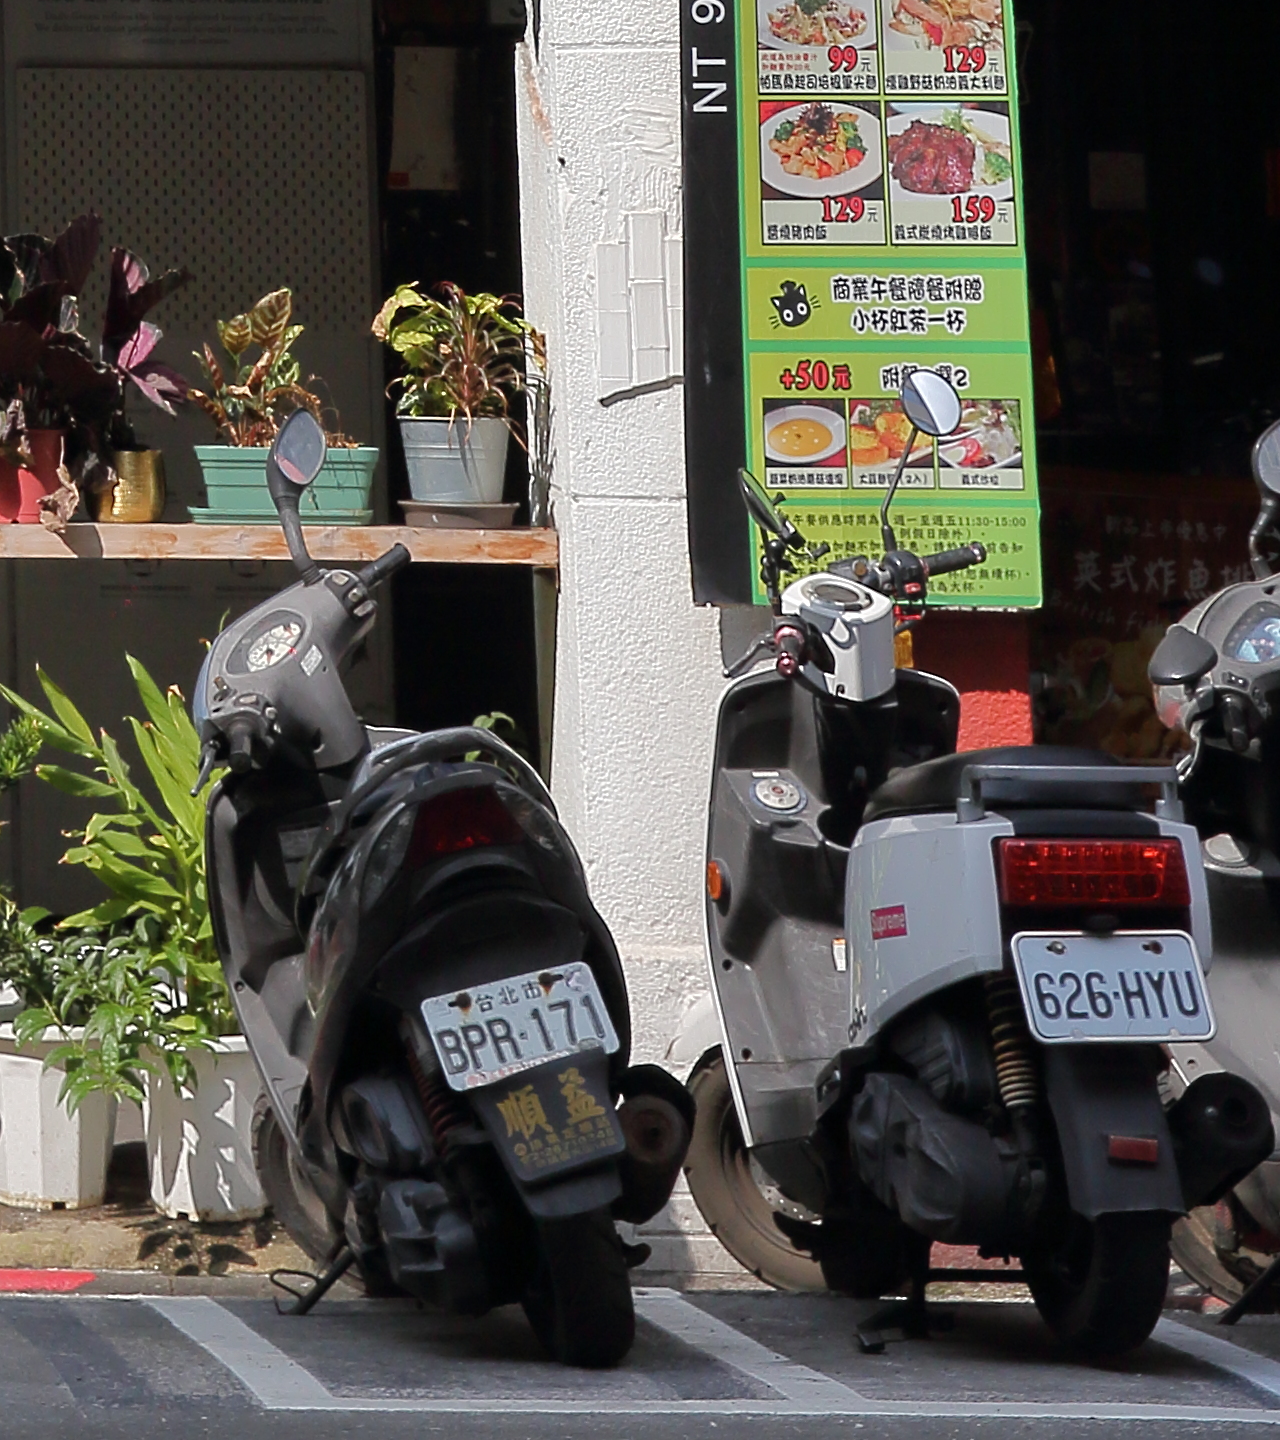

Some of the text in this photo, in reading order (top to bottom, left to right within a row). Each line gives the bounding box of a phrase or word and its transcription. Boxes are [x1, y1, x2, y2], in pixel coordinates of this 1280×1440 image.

[691, 46, 728, 114] NT
[832, 276, 982, 302] 商業午餐隨餐附贈
[851, 308, 966, 333] 小杯紅茶一杯
[475, 980, 541, 1013] 台北市
[1033, 970, 1200, 1020] 626-HYU
[436, 994, 606, 1075] BPR-171
